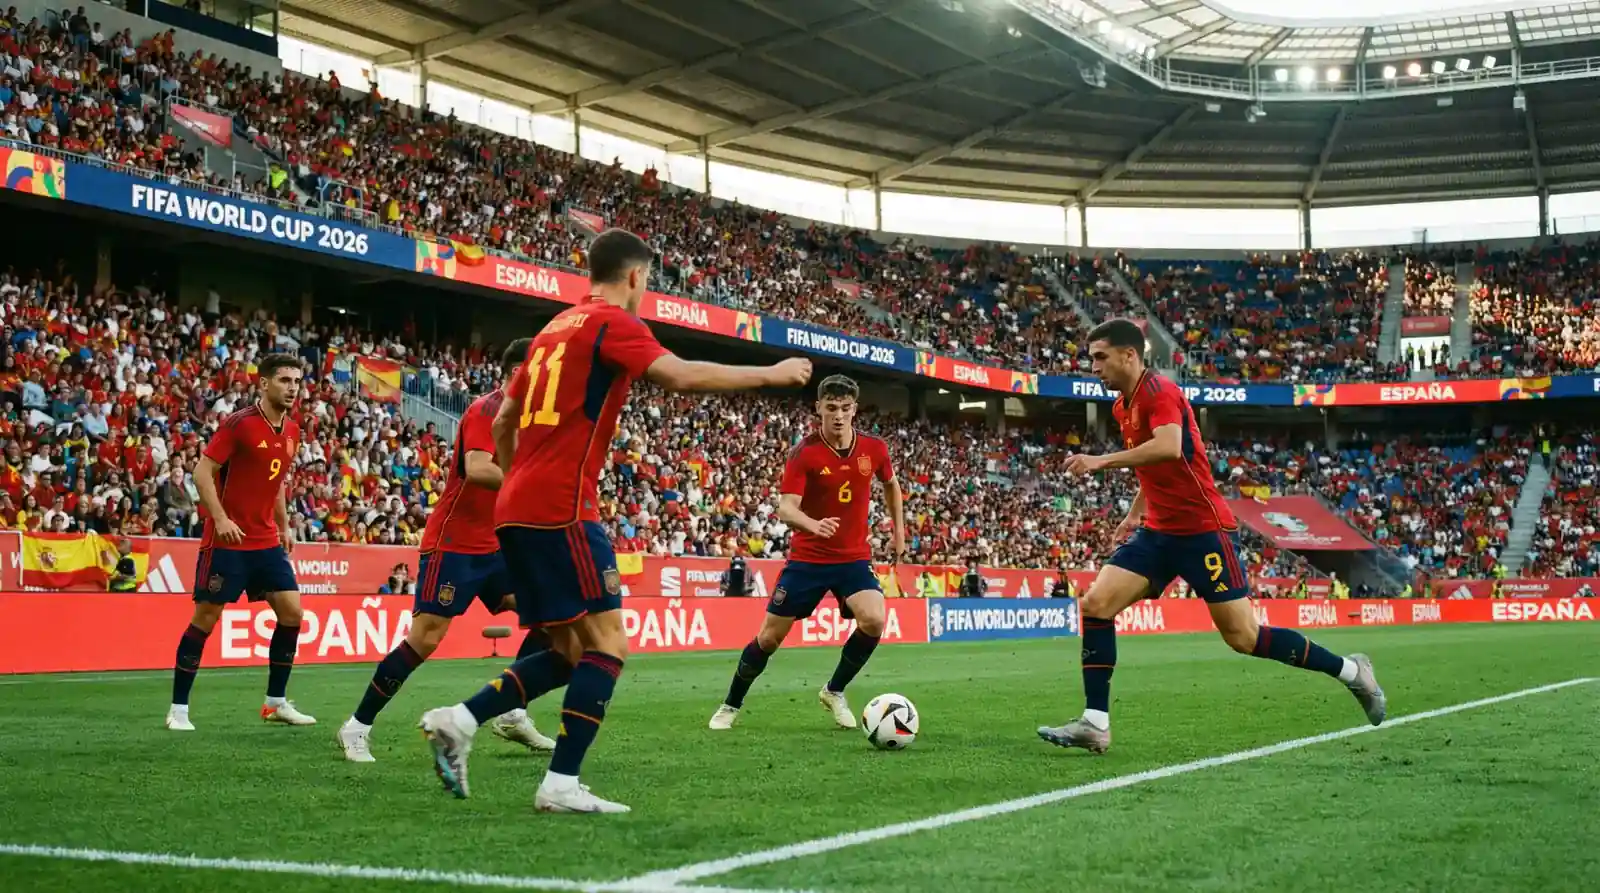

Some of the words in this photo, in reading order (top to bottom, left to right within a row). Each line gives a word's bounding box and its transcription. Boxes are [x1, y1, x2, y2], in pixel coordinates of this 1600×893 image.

[132, 184, 182, 217] FIFA
[186, 196, 267, 233] WORLD
[271, 215, 314, 242] CUP
[318, 224, 369, 255] 2026
[496, 264, 560, 296] ESPAÑA
[656, 299, 709, 327] ESPAÑA
[787, 328, 811, 347] FIFA
[810, 333, 848, 354] WORLD
[850, 341, 869, 358] CUP
[870, 345, 895, 364] 2026
[520, 342, 566, 428] 11
[954, 364, 989, 385] ESPAÑA
[1073, 381, 1104, 397] FIFA
[1204, 387, 1247, 401] 2026
[1380, 382, 1455, 400] ESPAÑA
[269, 459, 281, 480] 9
[839, 480, 852, 502] 6
[1204, 552, 1223, 581] 9
[622, 598, 711, 647] PAÑA
[946, 609, 974, 631] FIFA
[973, 608, 1017, 630] WORLD
[1017, 608, 1040, 629] CUP
[1040, 607, 1065, 629] 2026
[1115, 599, 1165, 632] SPAÑA
[1299, 600, 1338, 626] ESPAÑA
[1492, 598, 1594, 621] ESPAÑA
[221, 596, 412, 659] ESPAÑA
[802, 607, 901, 641] ESPA
